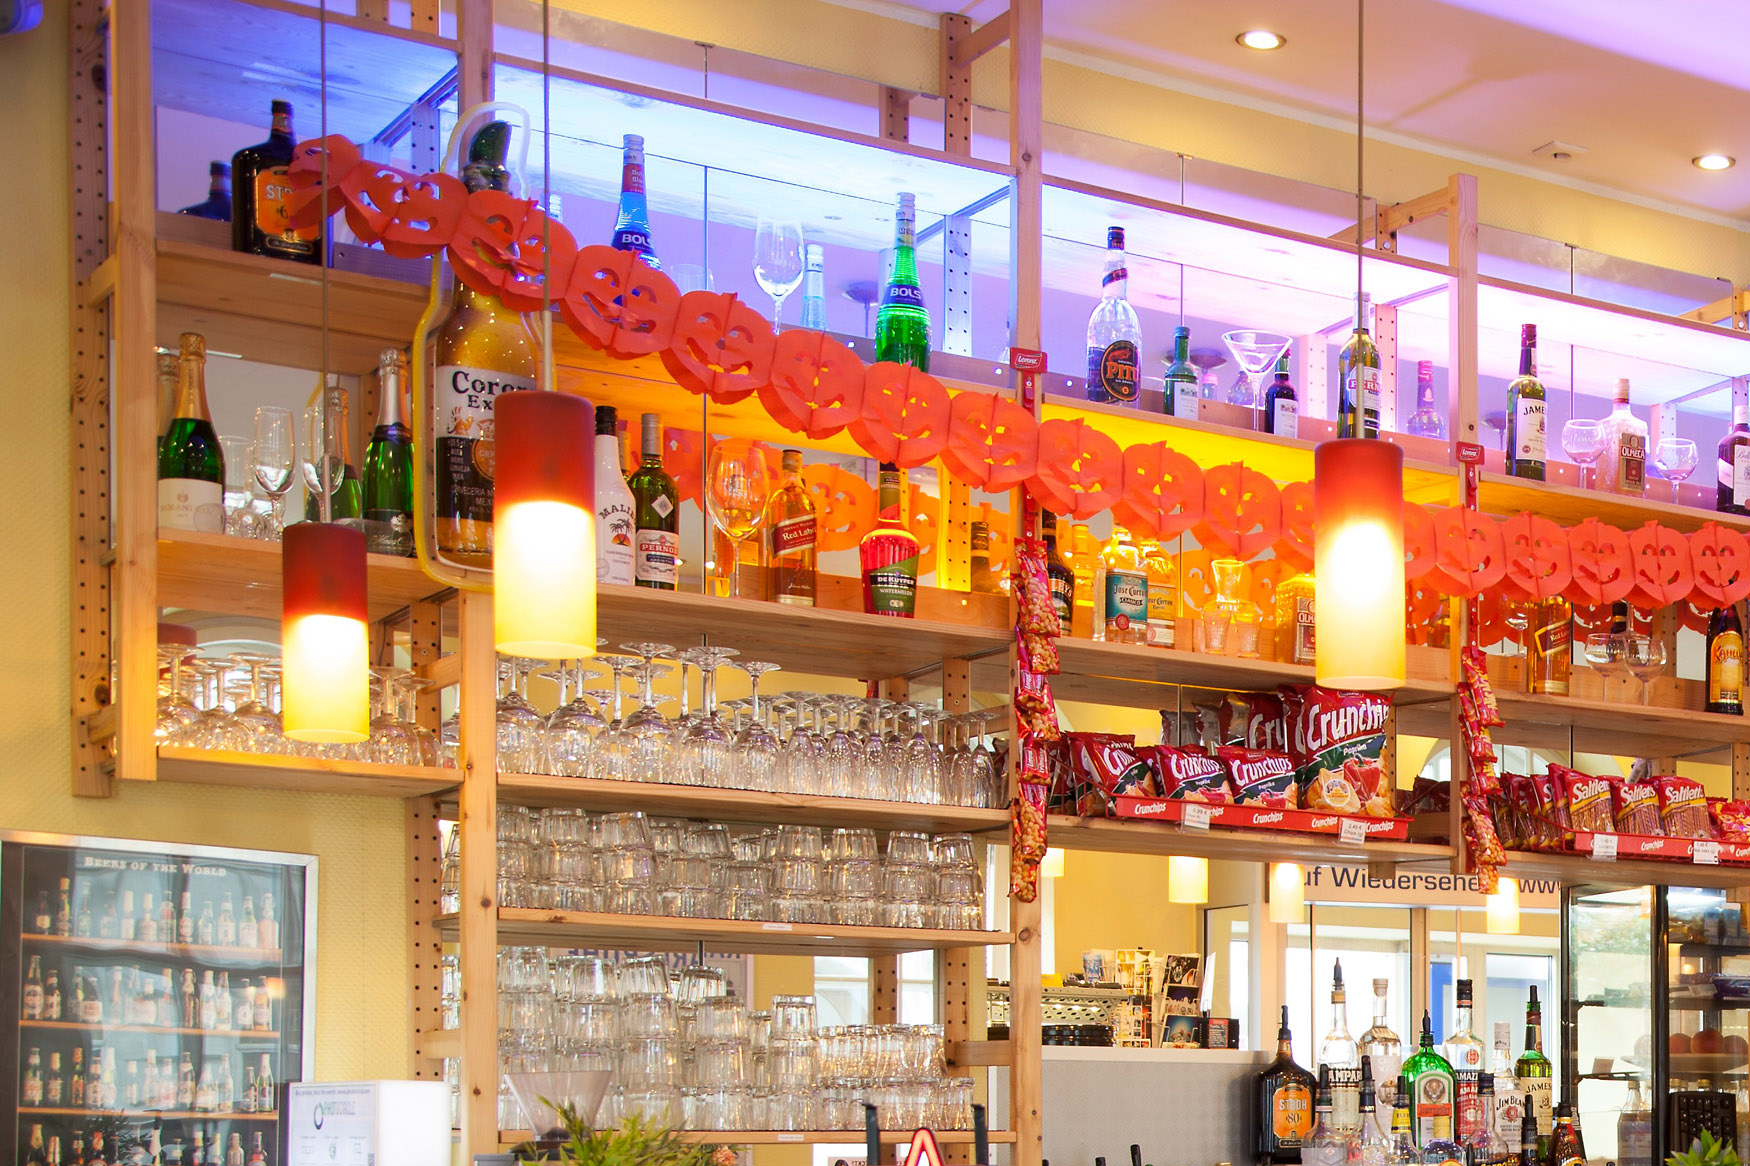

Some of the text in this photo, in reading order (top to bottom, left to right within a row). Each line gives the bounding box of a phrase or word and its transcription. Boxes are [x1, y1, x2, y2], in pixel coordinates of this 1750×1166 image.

[890, 287, 921, 299] BOLS
[452, 370, 527, 395] Coro
[1523, 405, 1546, 417] JAME
[1622, 447, 1645, 458] OLMECA
[782, 530, 798, 541] Red
[1343, 743, 1367, 755] Paprika
[1232, 755, 1293, 787] Crunchips
[1134, 802, 1166, 815] Crunchips
[1252, 811, 1283, 825] Crunchips
[1311, 816, 1338, 828] Crunchips
[1365, 820, 1394, 833] Crunchips
[1641, 839, 1664, 851] Crunchips
[84, 856, 226, 877] BEERS OF THE WORLD
[1526, 1082, 1552, 1094] JAMES
[1278, 1099, 1307, 1111] STROH
[1496, 1097, 1509, 1111] JIM
[1287, 1112, 1300, 1124] 80
